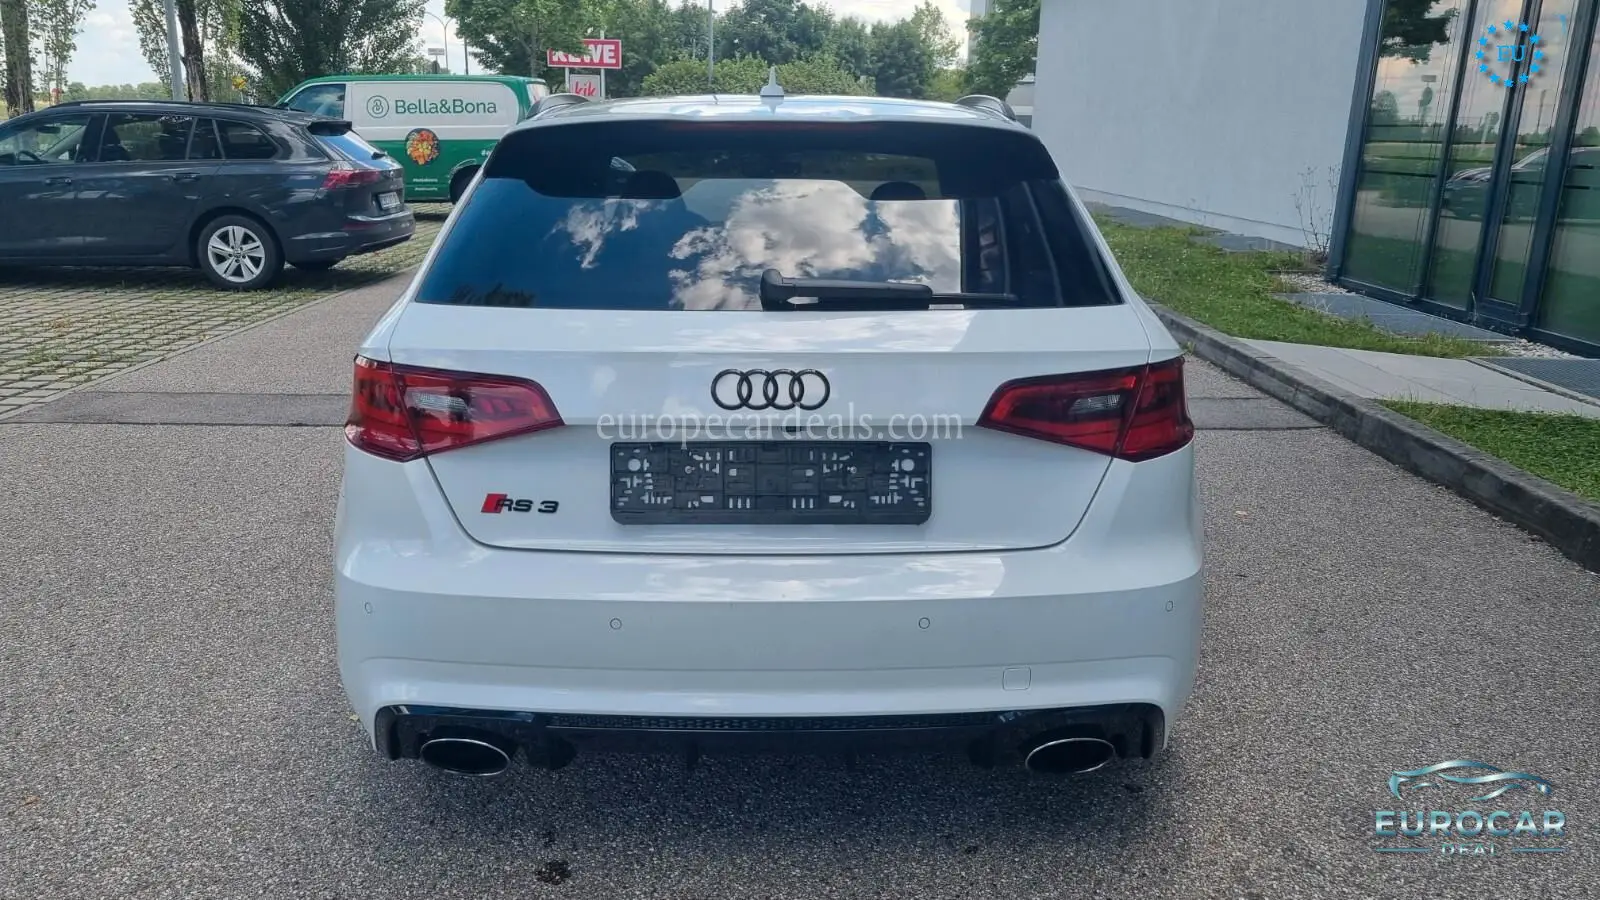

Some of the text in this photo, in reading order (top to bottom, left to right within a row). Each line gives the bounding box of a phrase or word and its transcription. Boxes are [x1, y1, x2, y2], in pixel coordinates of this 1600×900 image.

[575, 80, 596, 97] kik
[395, 99, 497, 115] Bella&Bona
[494, 498, 560, 514] RS 3
